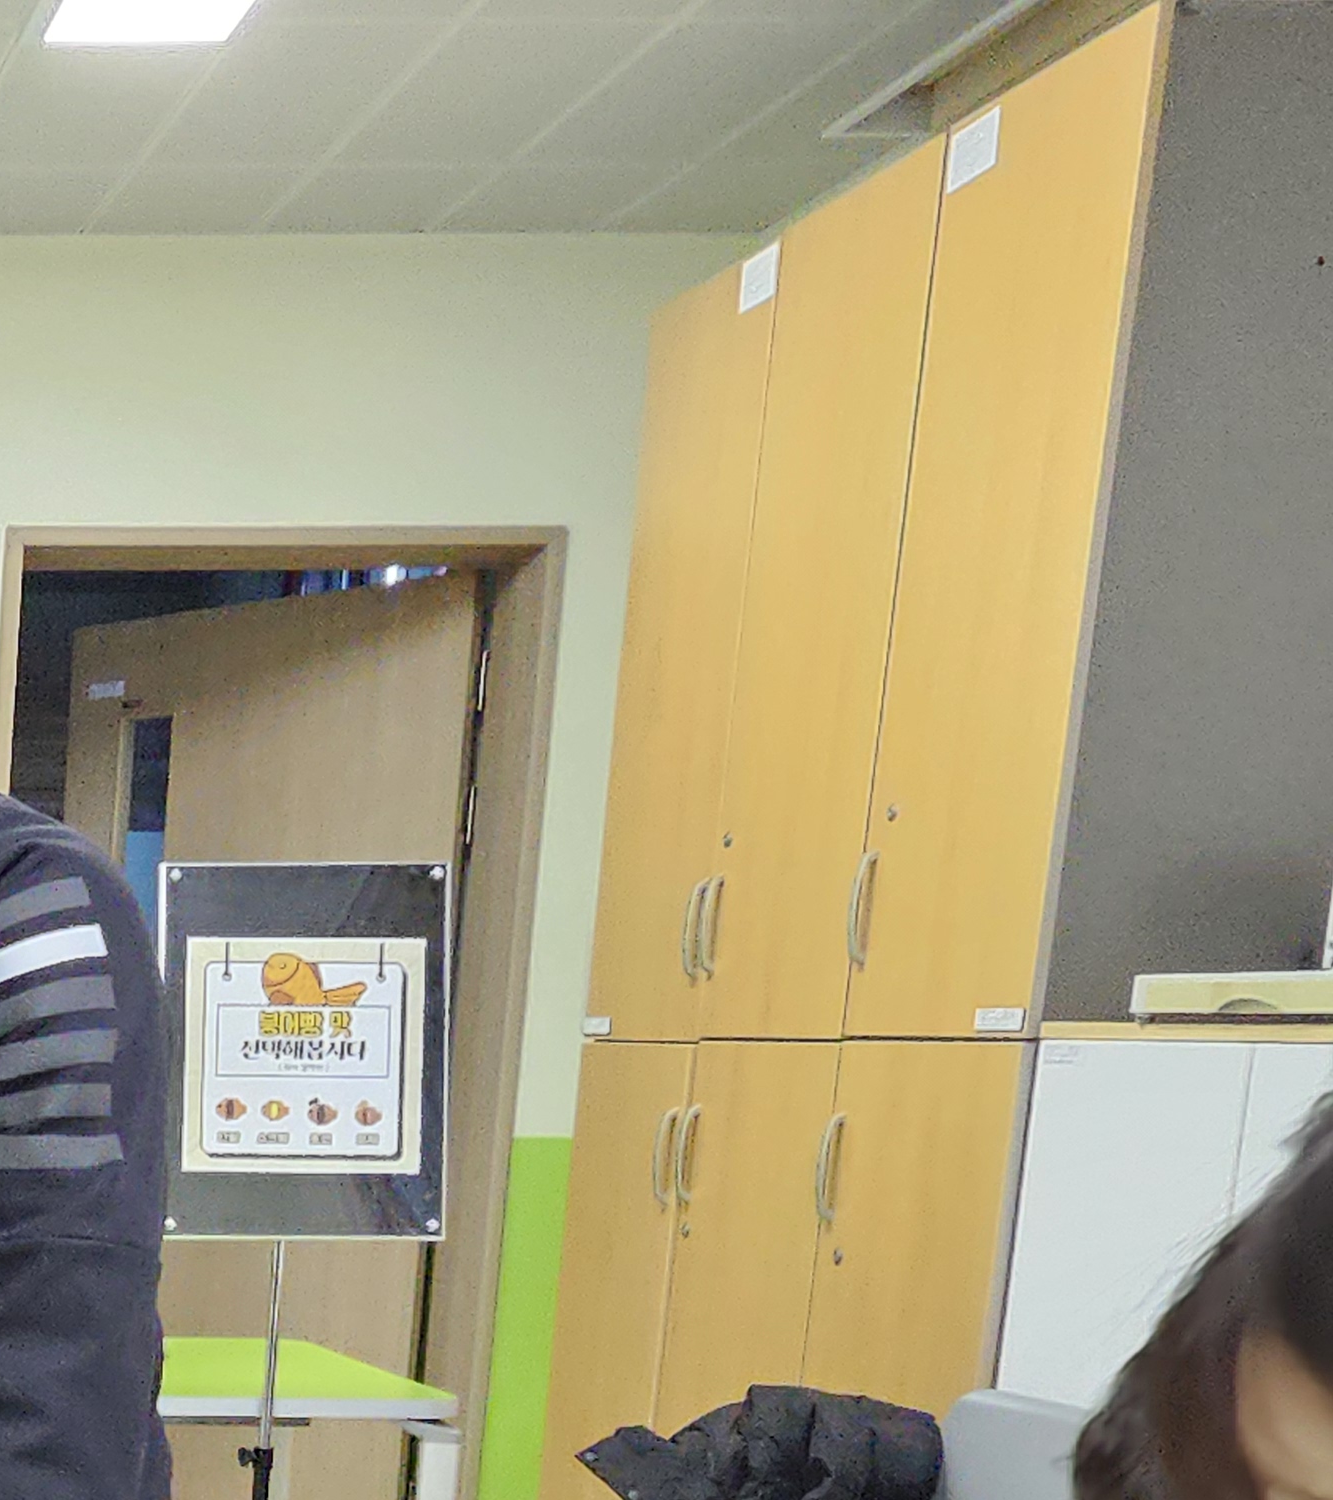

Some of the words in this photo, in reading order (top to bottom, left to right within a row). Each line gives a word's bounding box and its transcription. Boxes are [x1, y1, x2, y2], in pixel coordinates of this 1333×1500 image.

[259, 1010, 325, 1037] 붕어빵
[329, 1010, 353, 1038] 맛
[240, 1039, 366, 1061] 선택해봅시다
